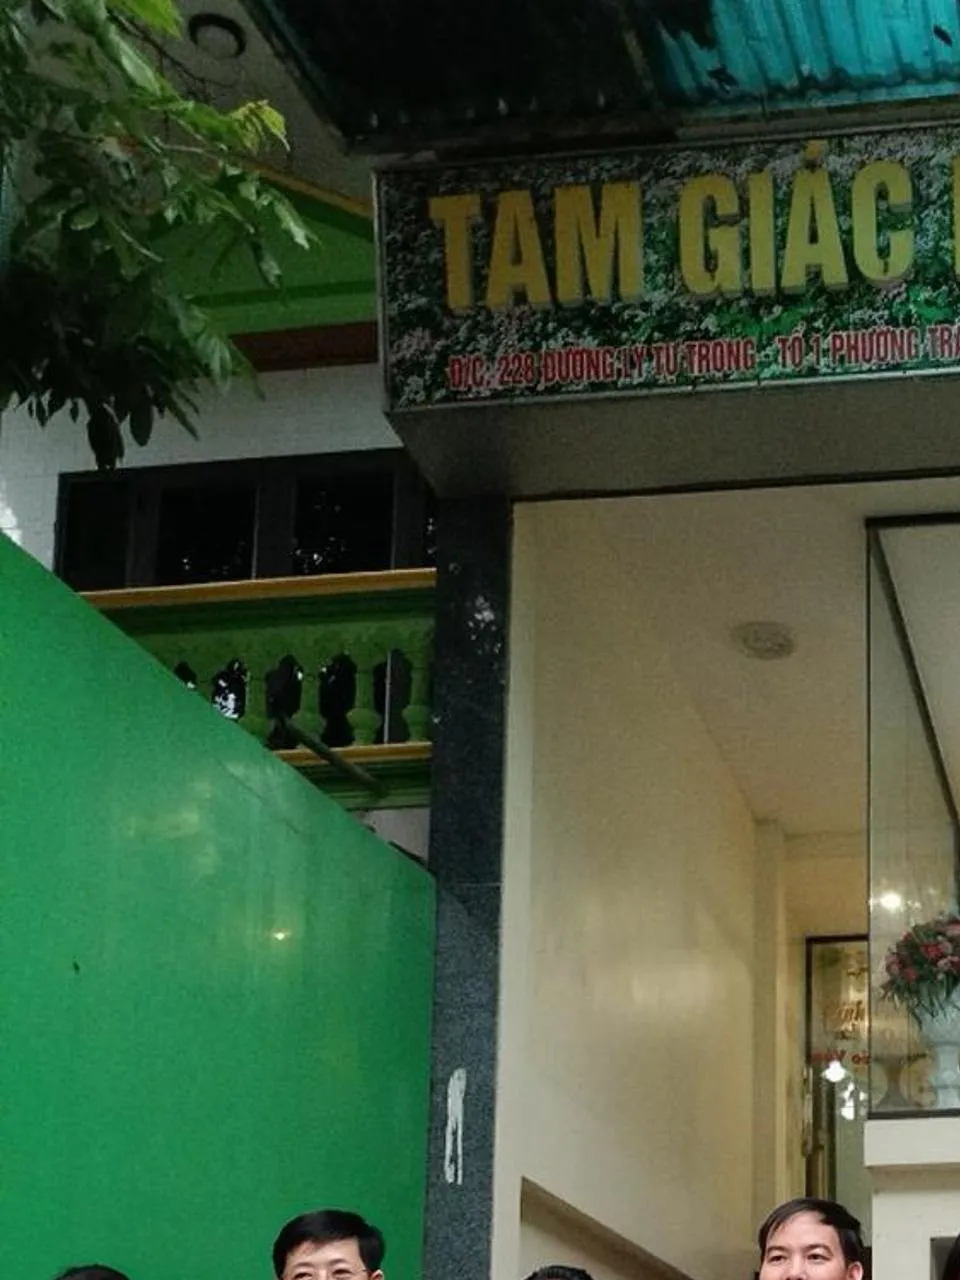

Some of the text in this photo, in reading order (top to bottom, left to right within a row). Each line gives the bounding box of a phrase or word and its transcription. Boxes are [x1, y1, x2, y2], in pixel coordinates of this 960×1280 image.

[430, 181, 643, 312] TAM
[678, 140, 914, 295] GIÁC
[498, 351, 535, 385] 228
